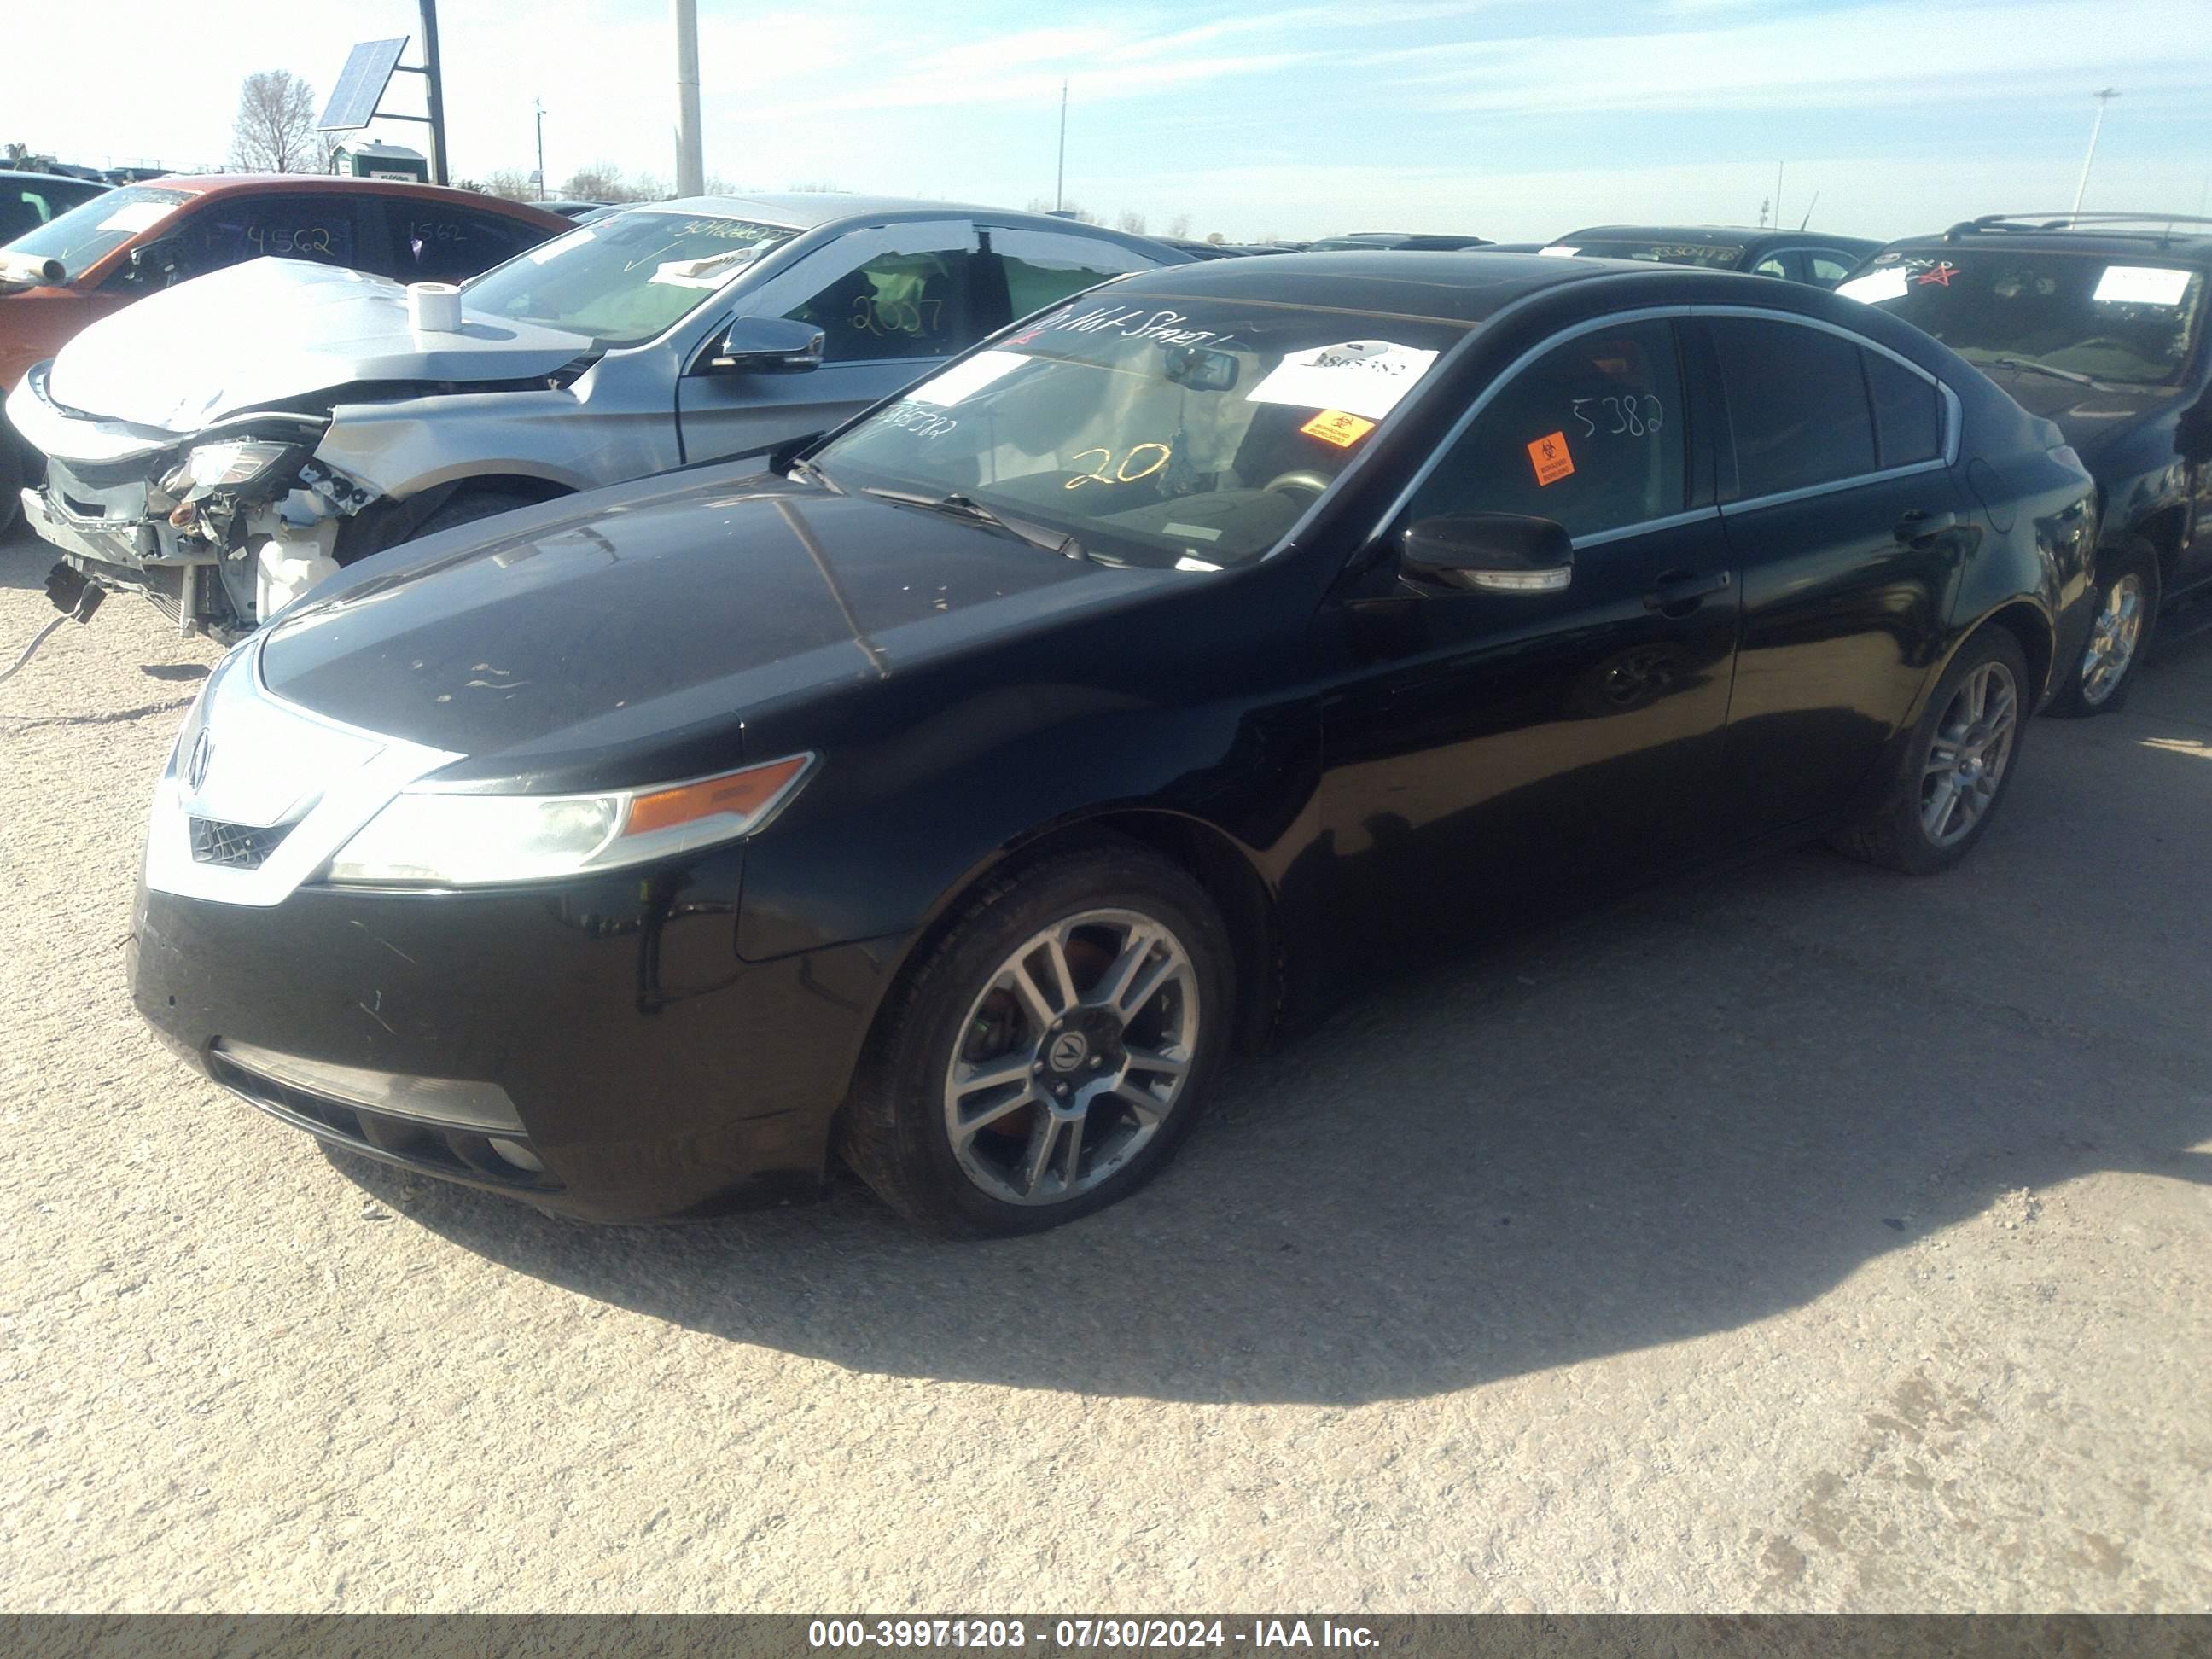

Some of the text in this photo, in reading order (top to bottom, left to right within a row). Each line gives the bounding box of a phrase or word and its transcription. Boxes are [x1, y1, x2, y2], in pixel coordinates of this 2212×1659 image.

[247, 225, 335, 255] 4562
[853, 295, 943, 337] 2007
[1572, 394, 1663, 438] 5382
[1065, 443, 1172, 489] 20
